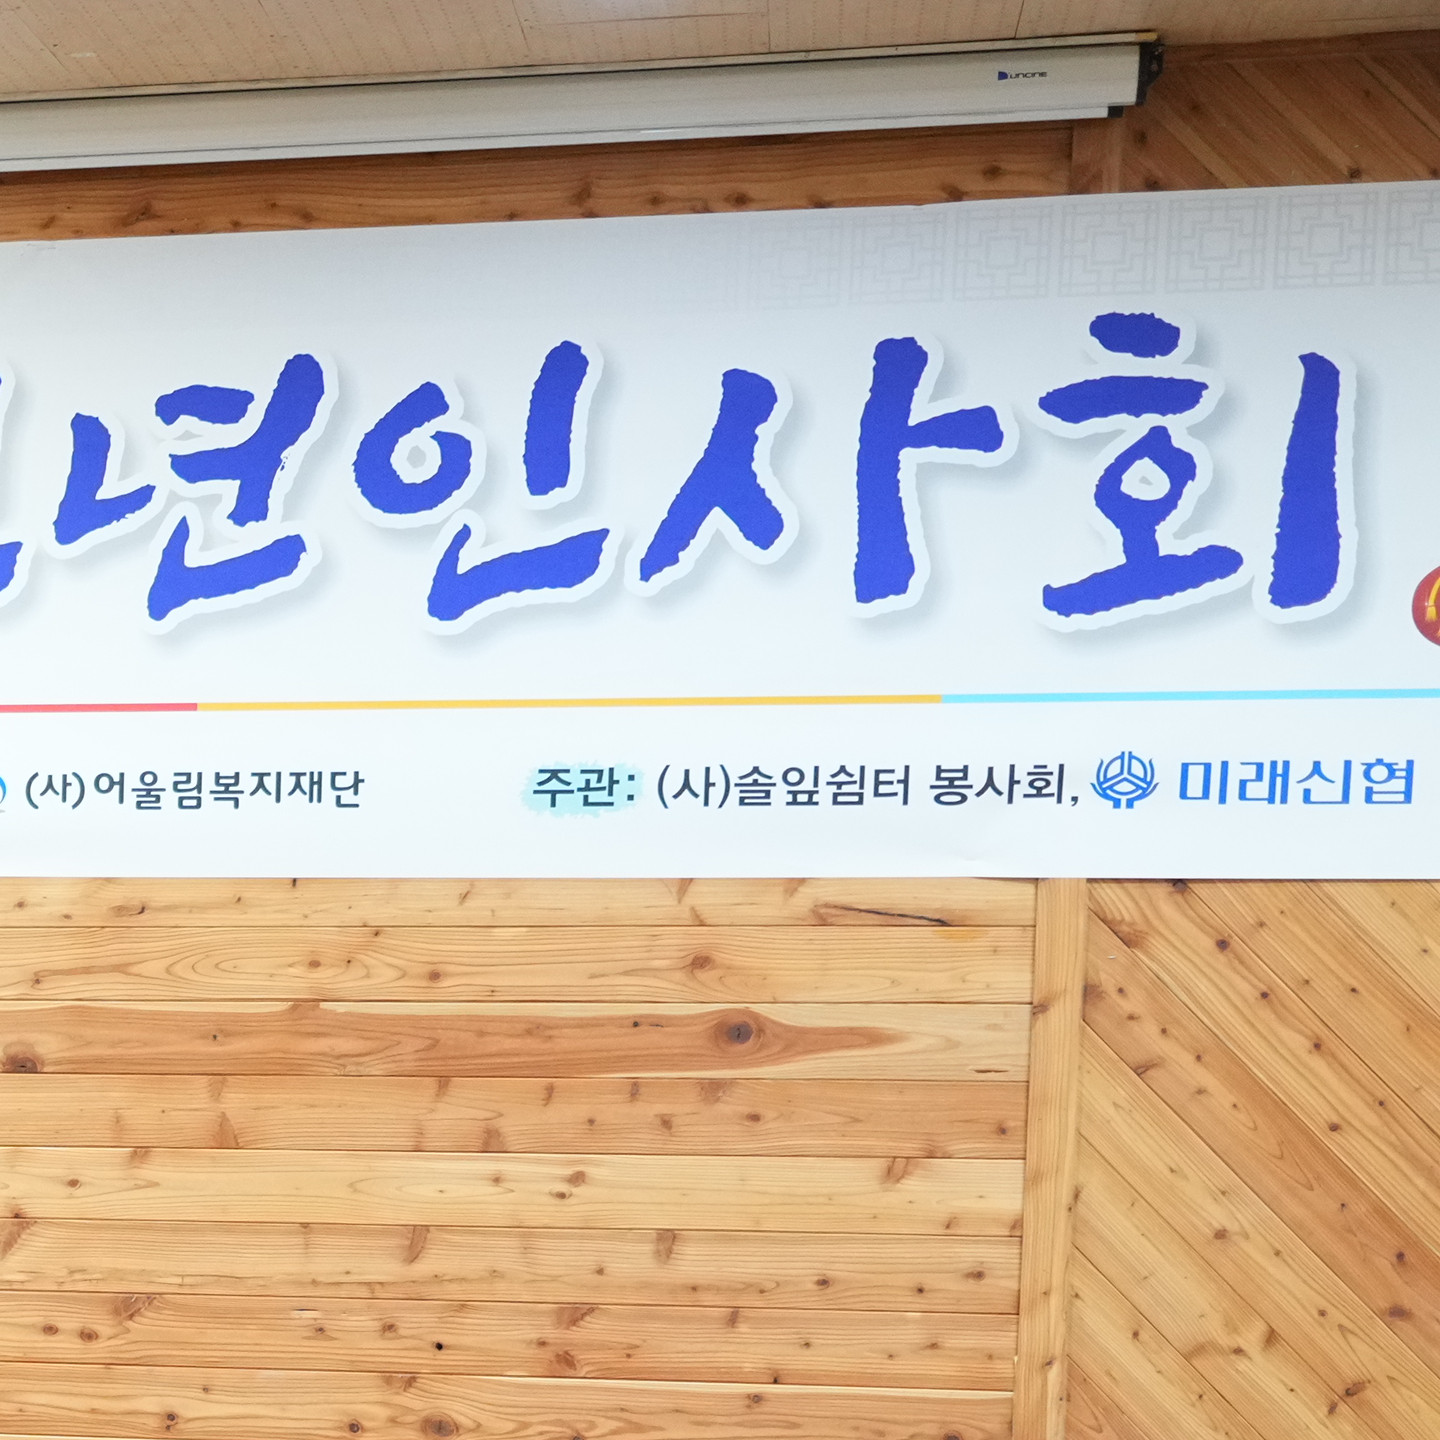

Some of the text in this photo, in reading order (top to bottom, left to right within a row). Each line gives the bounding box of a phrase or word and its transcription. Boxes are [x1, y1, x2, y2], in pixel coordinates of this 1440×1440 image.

[25, 770, 366, 811] (사)어울림복지재단
[531, 763, 1080, 810] 주관: (사)솔잎쉼터 봉사회,
[1178, 757, 1416, 806] 미래신협
